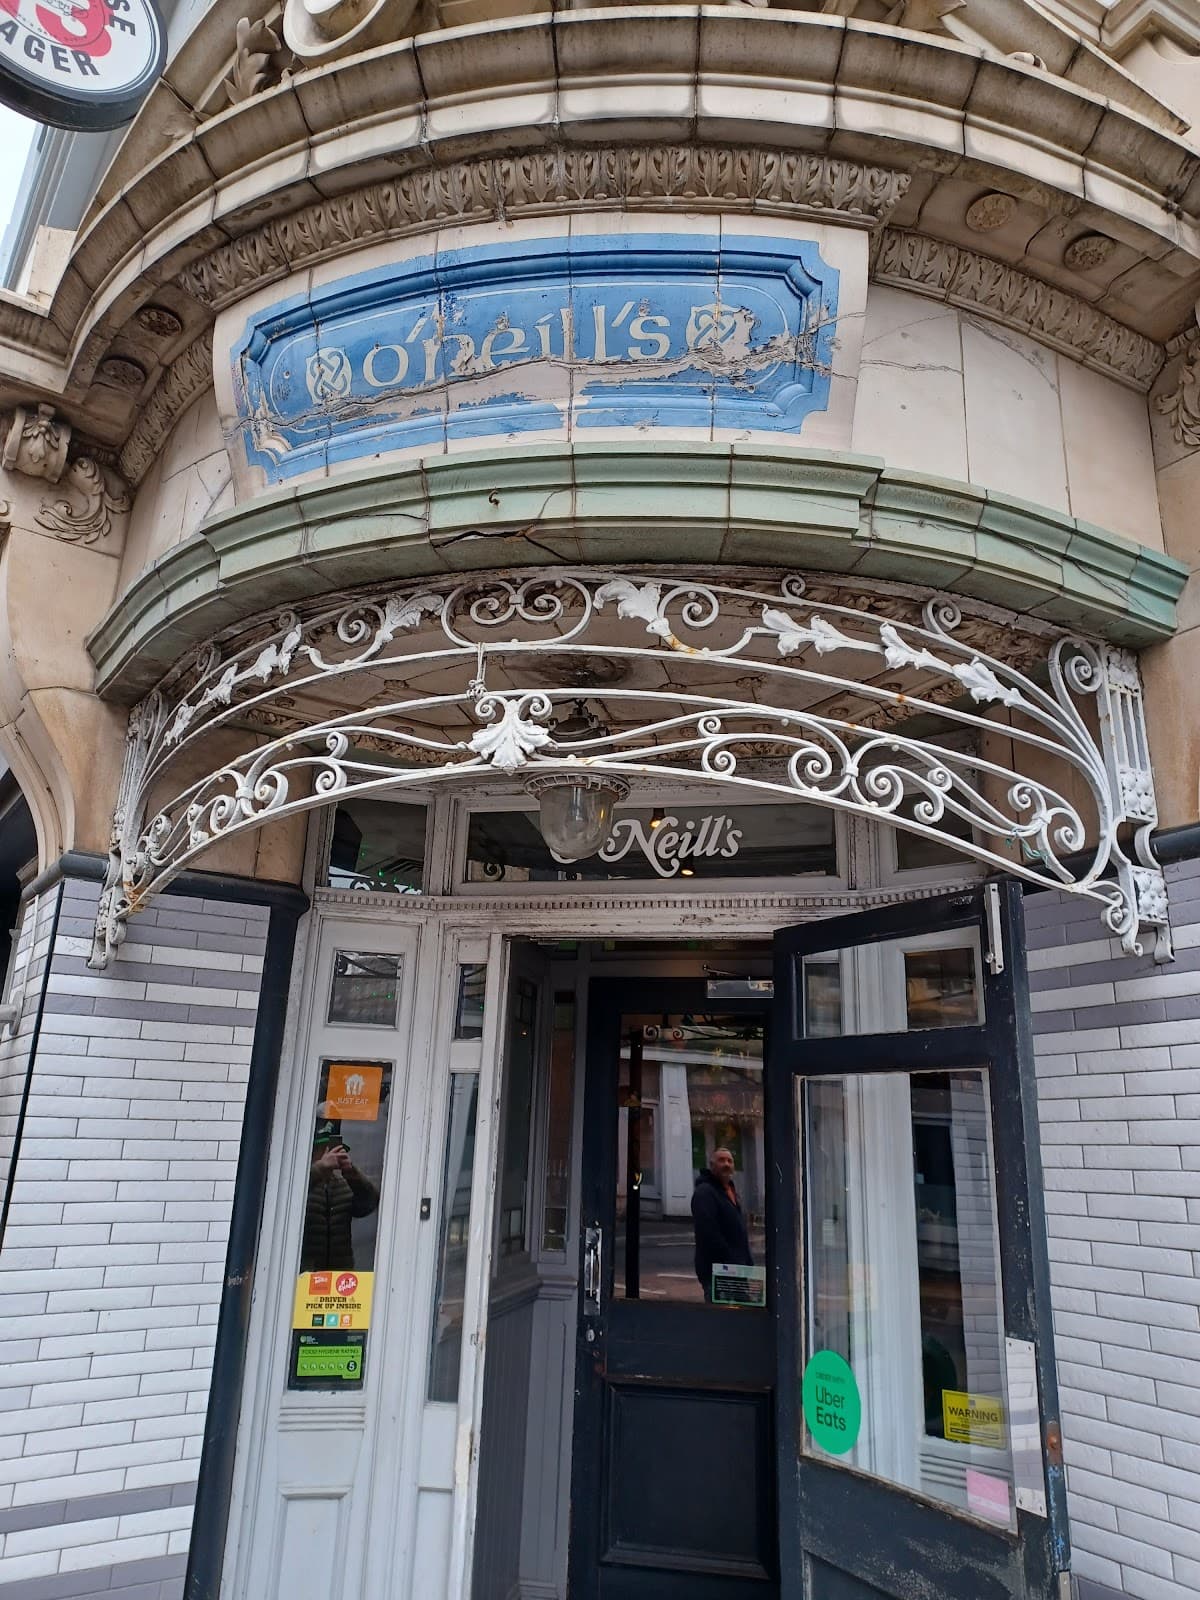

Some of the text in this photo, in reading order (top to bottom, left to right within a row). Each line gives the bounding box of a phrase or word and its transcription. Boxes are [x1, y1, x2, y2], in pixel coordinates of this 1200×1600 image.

[336, 1097, 354, 1105] JUST
[815, 1384, 846, 1408] Uber
[816, 1406, 847, 1432] Eats
[948, 1406, 999, 1423] WARNING
